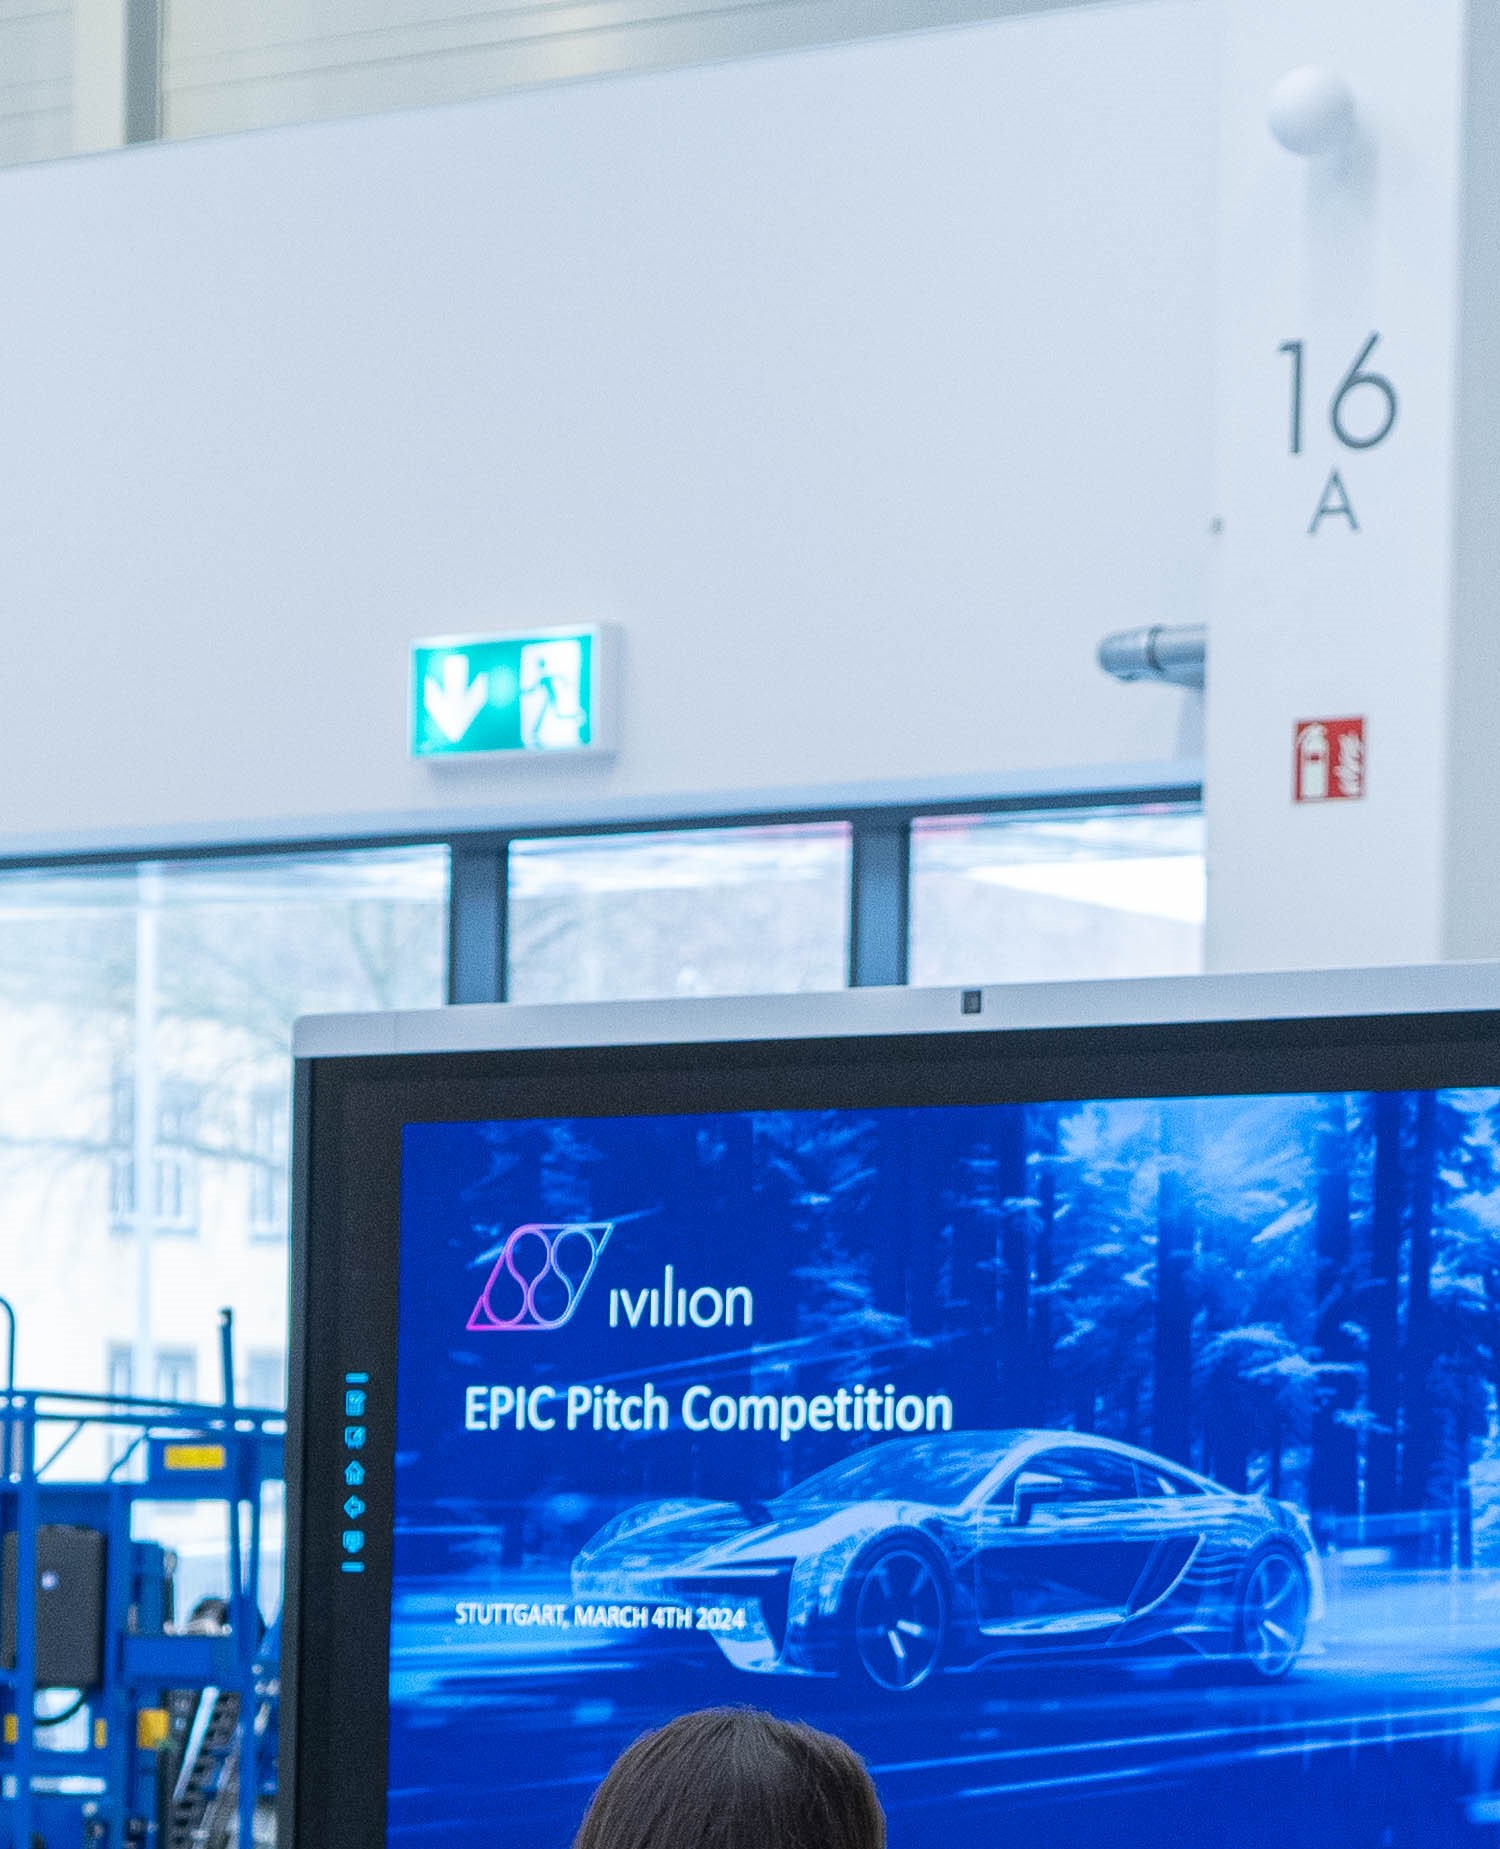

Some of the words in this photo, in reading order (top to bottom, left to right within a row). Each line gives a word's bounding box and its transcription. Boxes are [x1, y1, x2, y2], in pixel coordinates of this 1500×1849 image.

[1279, 331, 1398, 454] 16
[1308, 470, 1360, 534] A
[464, 1384, 556, 1432] EPIC
[567, 1382, 669, 1432] Pitch
[681, 1383, 954, 1442] Competition
[455, 1602, 570, 1630] STUTTGART,
[574, 1604, 648, 1629] MARCH
[652, 1606, 692, 1630] 4TH
[696, 1607, 746, 1631] 2024
